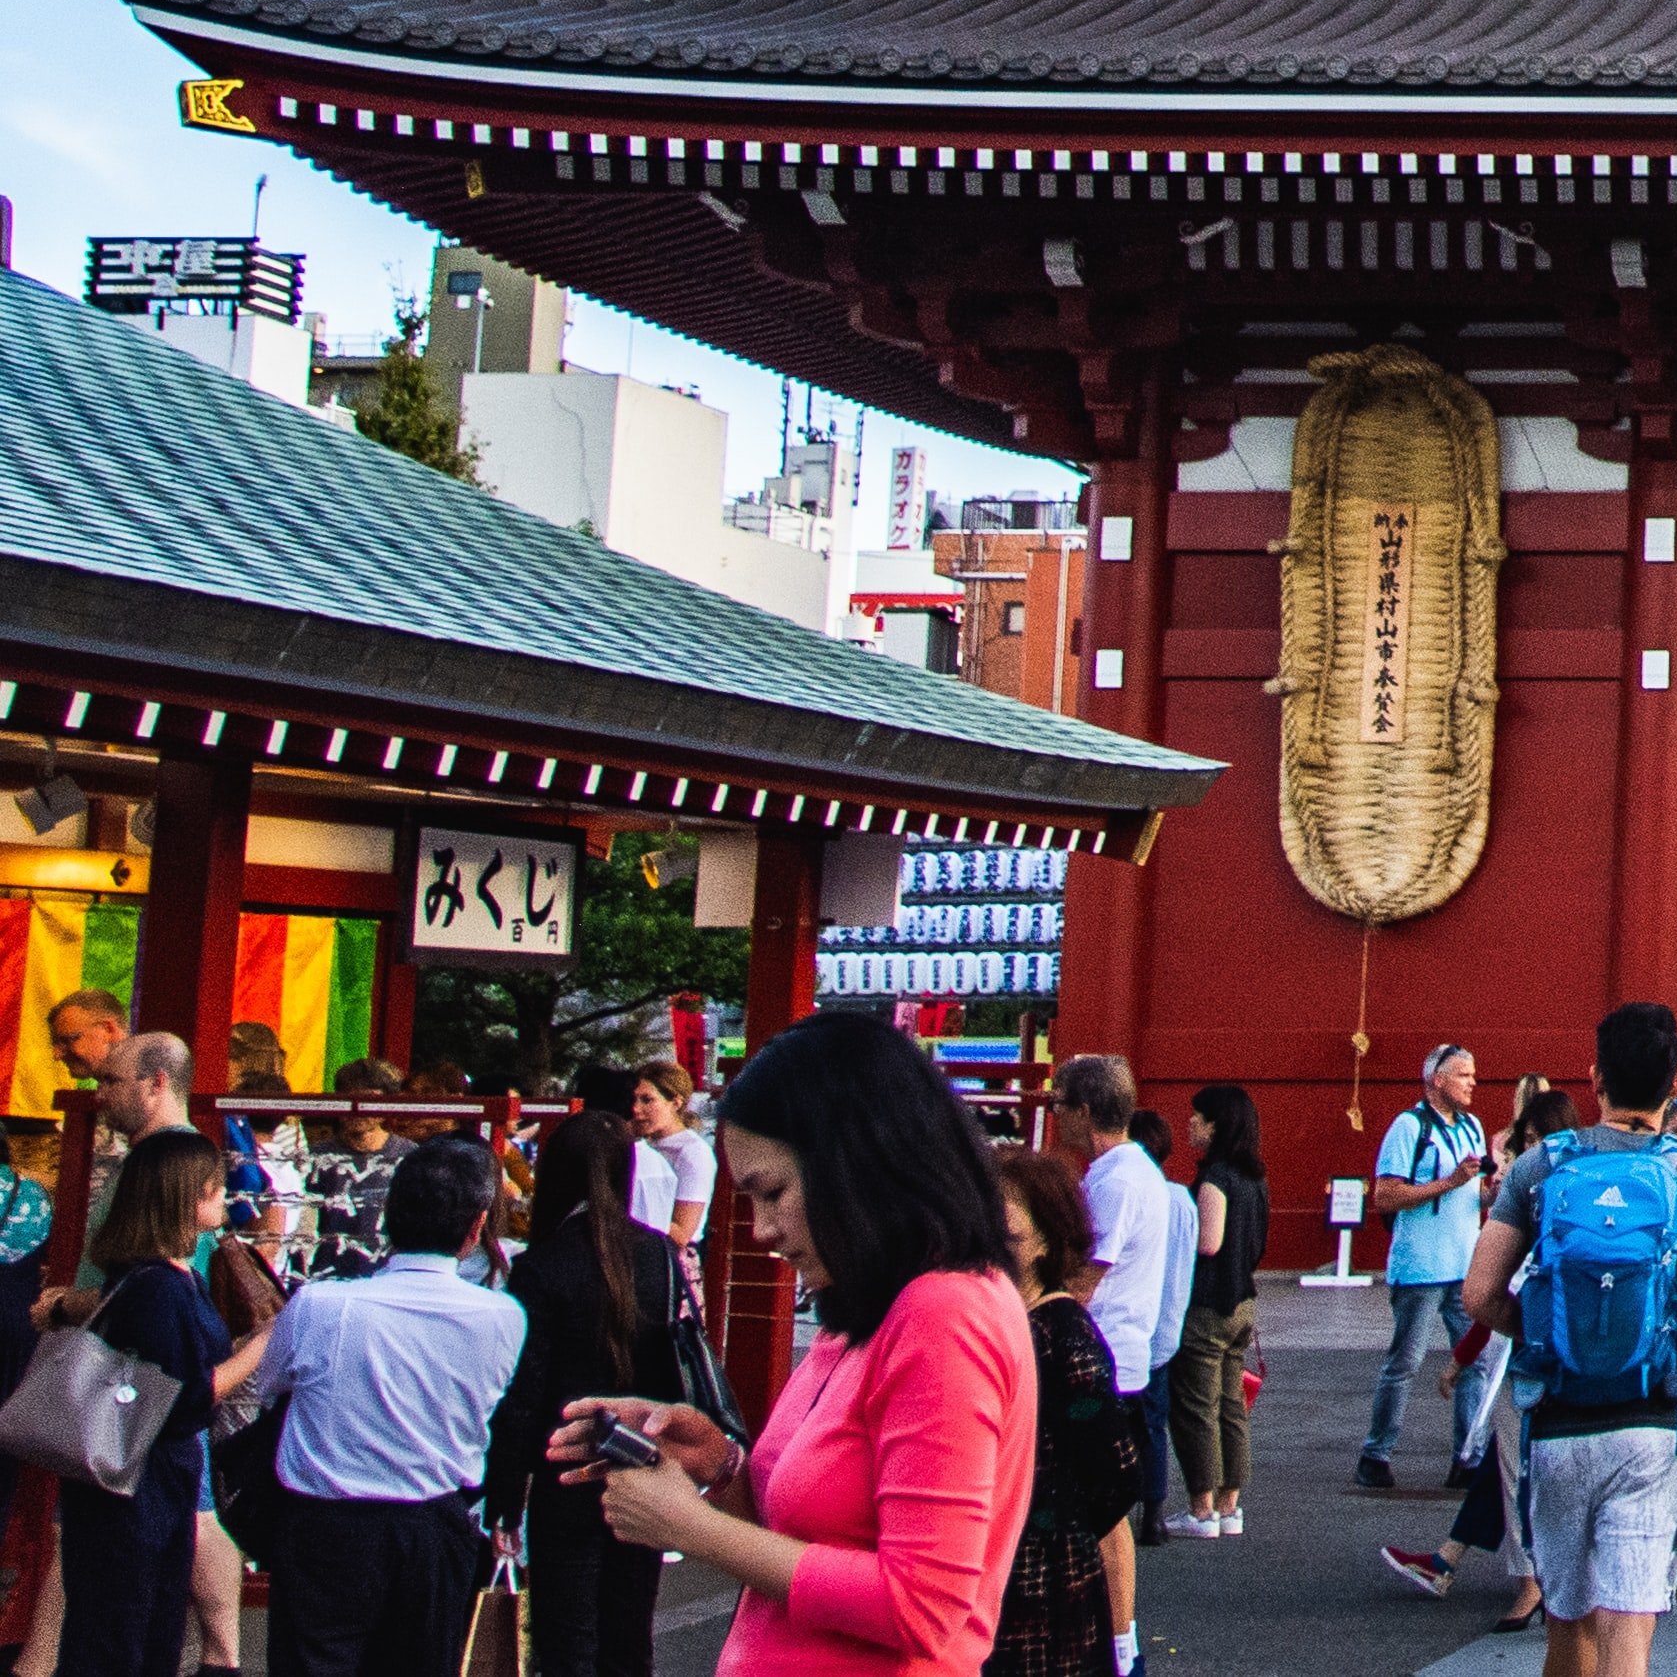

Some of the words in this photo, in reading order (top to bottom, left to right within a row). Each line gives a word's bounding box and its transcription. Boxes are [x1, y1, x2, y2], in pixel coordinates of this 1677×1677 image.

[890, 451, 912, 544] カラオケ
[424, 847, 558, 931] みくじ
